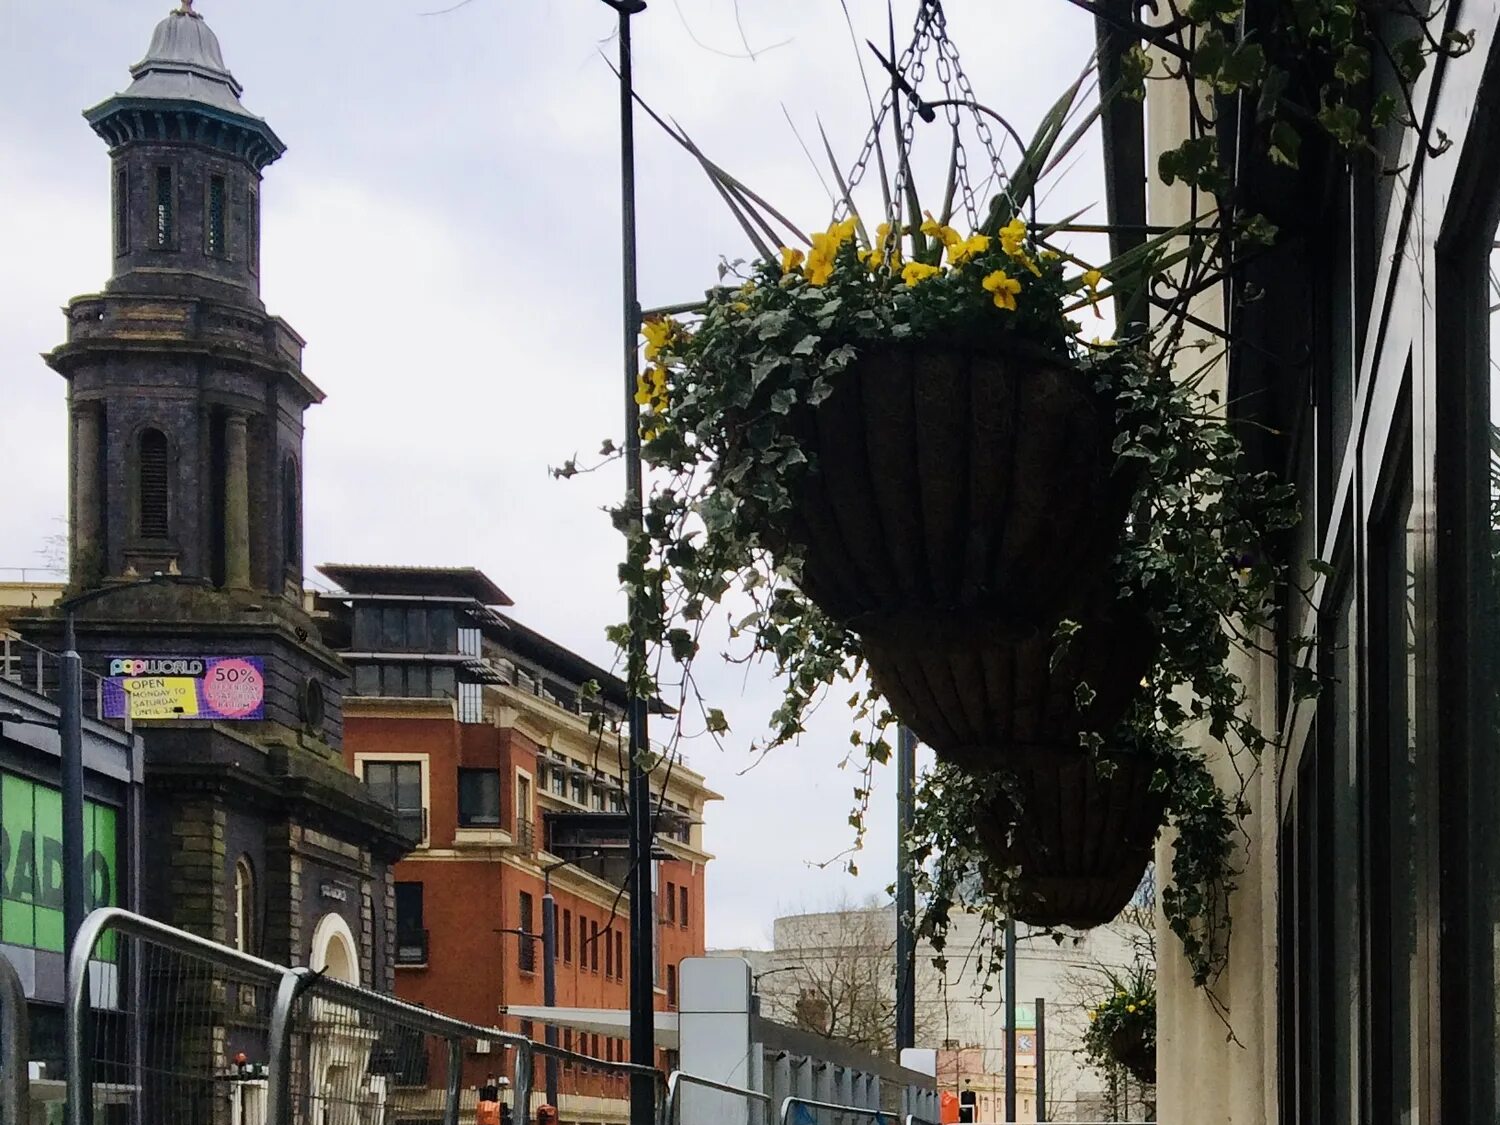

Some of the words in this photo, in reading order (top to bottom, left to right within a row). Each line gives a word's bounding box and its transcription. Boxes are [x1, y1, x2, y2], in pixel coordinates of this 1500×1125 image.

[215, 667, 255, 683] 50%
[131, 678, 165, 690] OPEN
[132, 689, 171, 699] MONDAY
[174, 687, 187, 696] TO
[133, 698, 179, 708] SATURDAY
[0, 826, 111, 914] ADO
